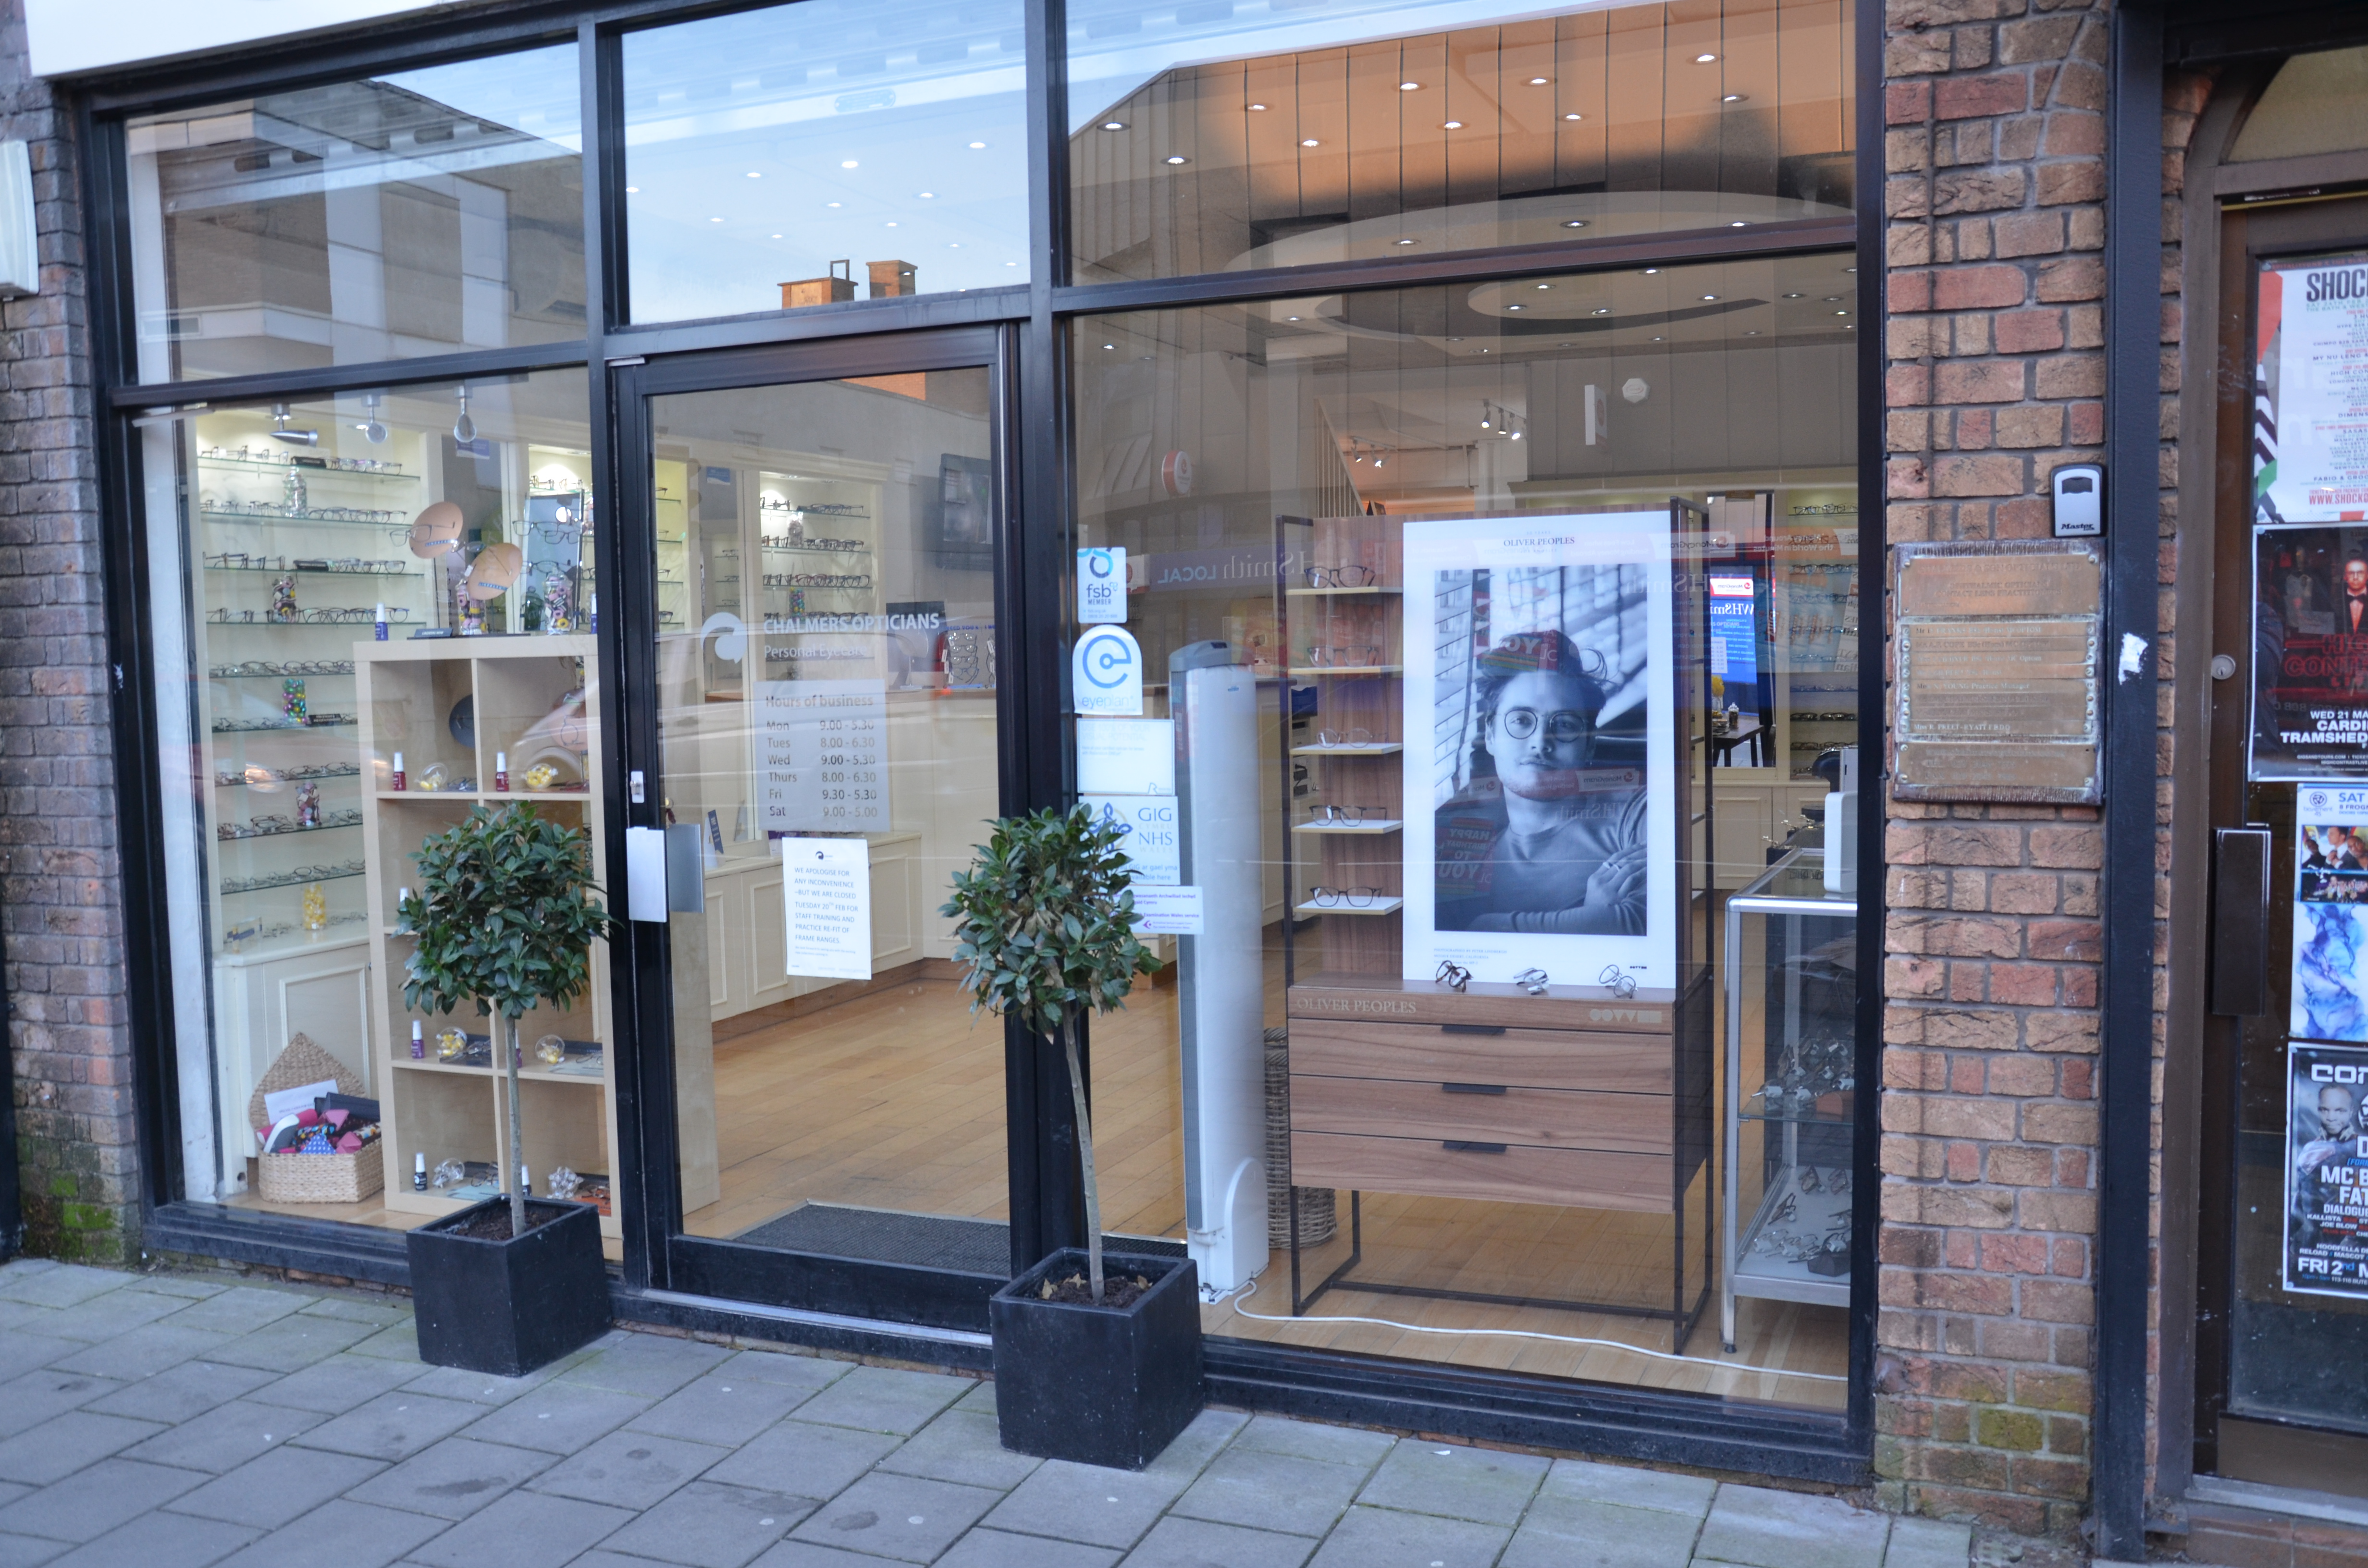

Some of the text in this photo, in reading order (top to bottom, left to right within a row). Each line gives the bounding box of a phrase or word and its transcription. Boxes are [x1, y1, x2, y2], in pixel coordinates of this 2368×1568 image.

[2306, 268, 2368, 302] SHOC
[1504, 536, 1575, 547] OLIVER PEOPLES
[1086, 583, 1111, 599] fsb
[763, 612, 940, 635] CHALMERS OPTICIANS
[764, 643, 867, 660] Personal Eyecare
[765, 694, 874, 708] Hours of business
[2310, 710, 2335, 720] WED
[2337, 710, 2349, 719] 21
[767, 720, 874, 731] Mon 9.00 5.30
[2316, 720, 2368, 732] CARDI
[767, 737, 875, 748] Tues 8.00 6.30
[2280, 732, 2368, 744] TRAMSHED
[768, 754, 876, 765] Wed 9.00 5.30
[768, 772, 876, 783] Thurs 8.00 6.30
[769, 788, 877, 800] Fri 9.30 5.30
[2338, 792, 2365, 803] SAT
[769, 805, 878, 817] Sat 9.00 5.00
[1138, 808, 1172, 821] GIG
[1139, 832, 1172, 845] NHS
[805, 868, 837, 876] APOLOGISE
[808, 878, 854, 889] INCONVENIENCE
[795, 901, 820, 909] TUESDAY
[813, 914, 841, 922] TRAINING
[795, 924, 822, 932] PRACTICE
[816, 936, 841, 944] RANGES.
[1295, 997, 1417, 1014] OLIVER PEOPLES
[2320, 1165, 2354, 1185] MC
[2306, 1213, 2342, 1223] KALLISTA
[2316, 1243, 2360, 1253] HOODFELLA
[2299, 1247, 2365, 1261] RELOAD MASCOT
[2298, 1257, 2356, 1276] FRI 2nd
